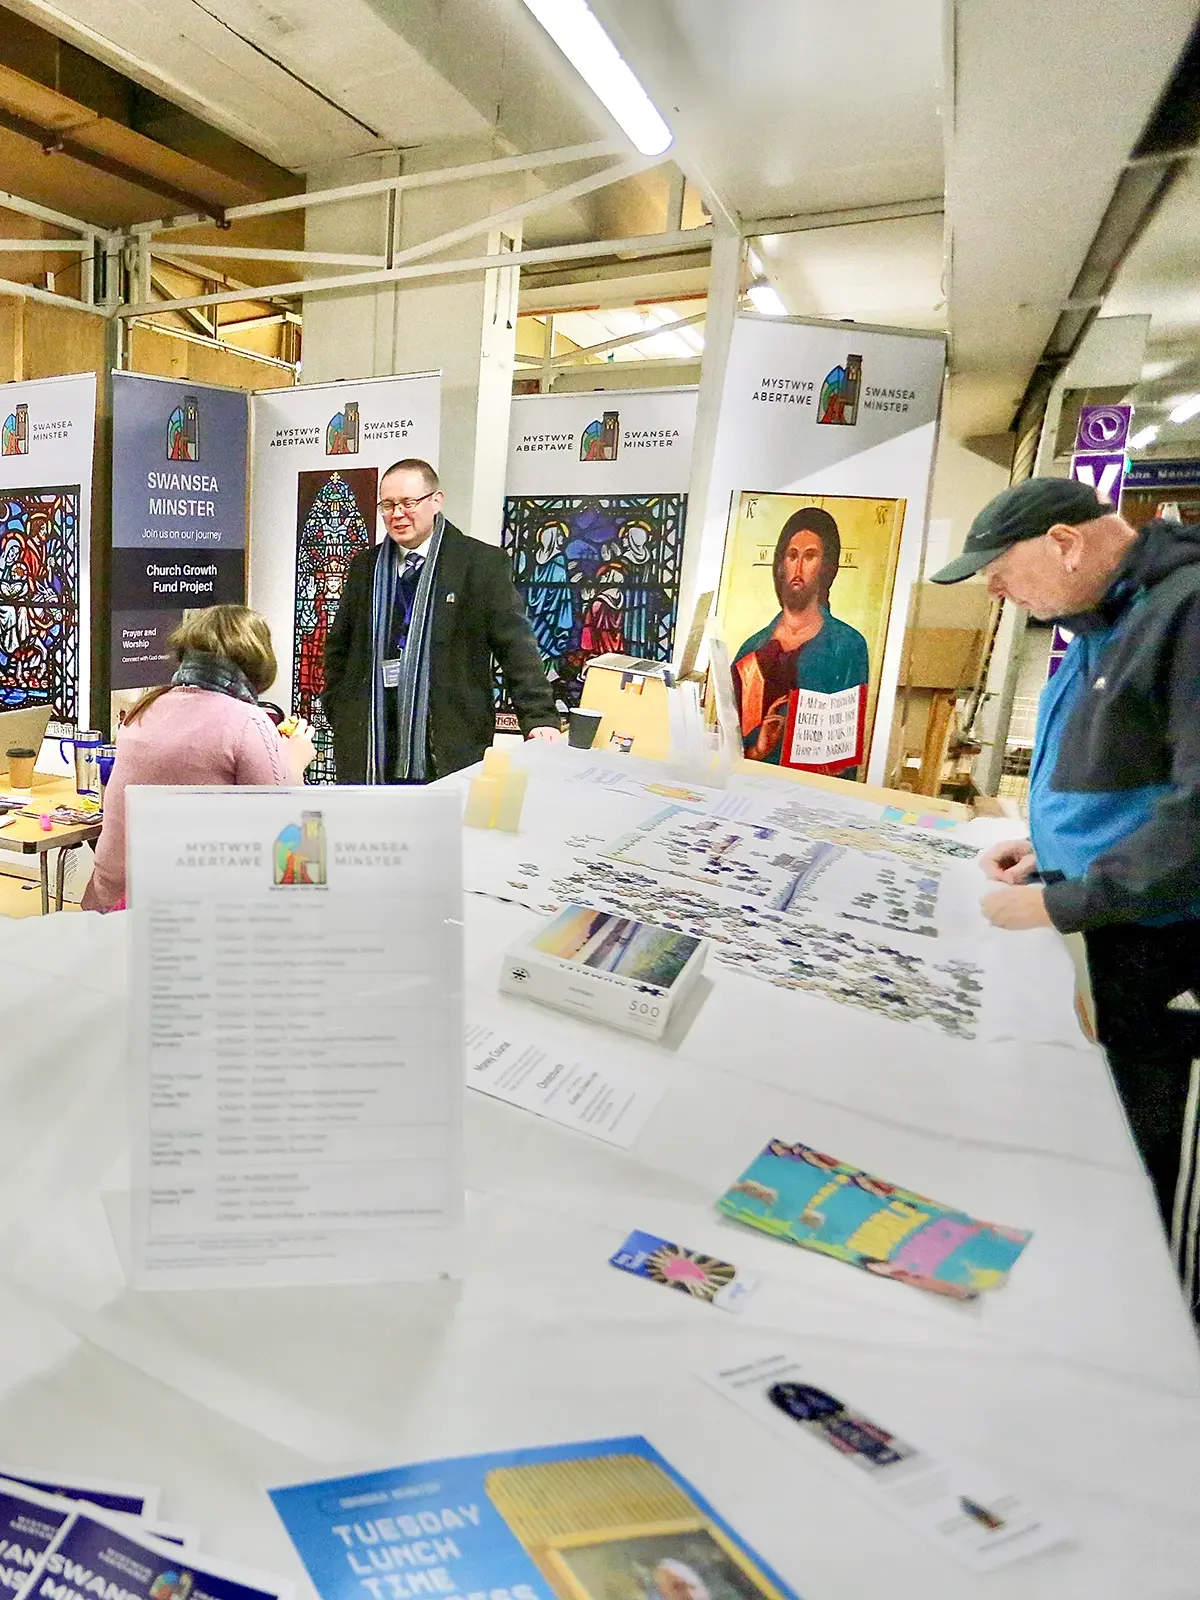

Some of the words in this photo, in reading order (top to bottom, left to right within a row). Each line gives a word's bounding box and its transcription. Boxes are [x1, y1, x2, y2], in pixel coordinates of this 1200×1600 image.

[761, 378, 815, 392] MYSTWYR
[865, 386, 916, 399] SWANSEA
[752, 391, 813, 406] ABERTAWE
[863, 401, 909, 413] MINSTER
[32, 420, 73, 432] SWANSEA
[364, 420, 414, 431] SWANSEA
[32, 430, 69, 441] MINSTER
[276, 427, 321, 437] MYSTWYR
[364, 430, 409, 440] MINSTER
[523, 433, 575, 442] MYSTWYR
[624, 430, 680, 439] SWANSEA
[270, 437, 320, 447] ABERTAWE
[516, 443, 573, 452] ABERTAWE
[623, 440, 674, 448] MINSTER
[147, 471, 219, 492] SWANSEA
[149, 498, 215, 517] MINSTER
[141, 528, 158, 539] Join
[160, 531, 168, 539] us
[169, 531, 180, 539] on
[181, 531, 194, 539] our
[195, 530, 222, 541] journey
[146, 564, 181, 576] Church
[183, 564, 217, 576] Growth
[153, 581, 177, 593] Fund
[180, 581, 213, 594] Project
[122, 629, 143, 639] Prayer
[144, 628, 156, 637] and
[122, 640, 150, 649] Worship
[186, 842, 263, 853] MYSTWYR
[334, 842, 409, 853] SWANSEA
[175, 856, 263, 867] ABERTAWE
[335, 856, 402, 866] MINSTER
[629, 1000, 660, 1018] 500
[331, 1504, 481, 1547] TUESDAY
[346, 1537, 462, 1575] LUNCH
[45, 1552, 140, 1600] SWAN
[360, 1567, 456, 1599] TIME
